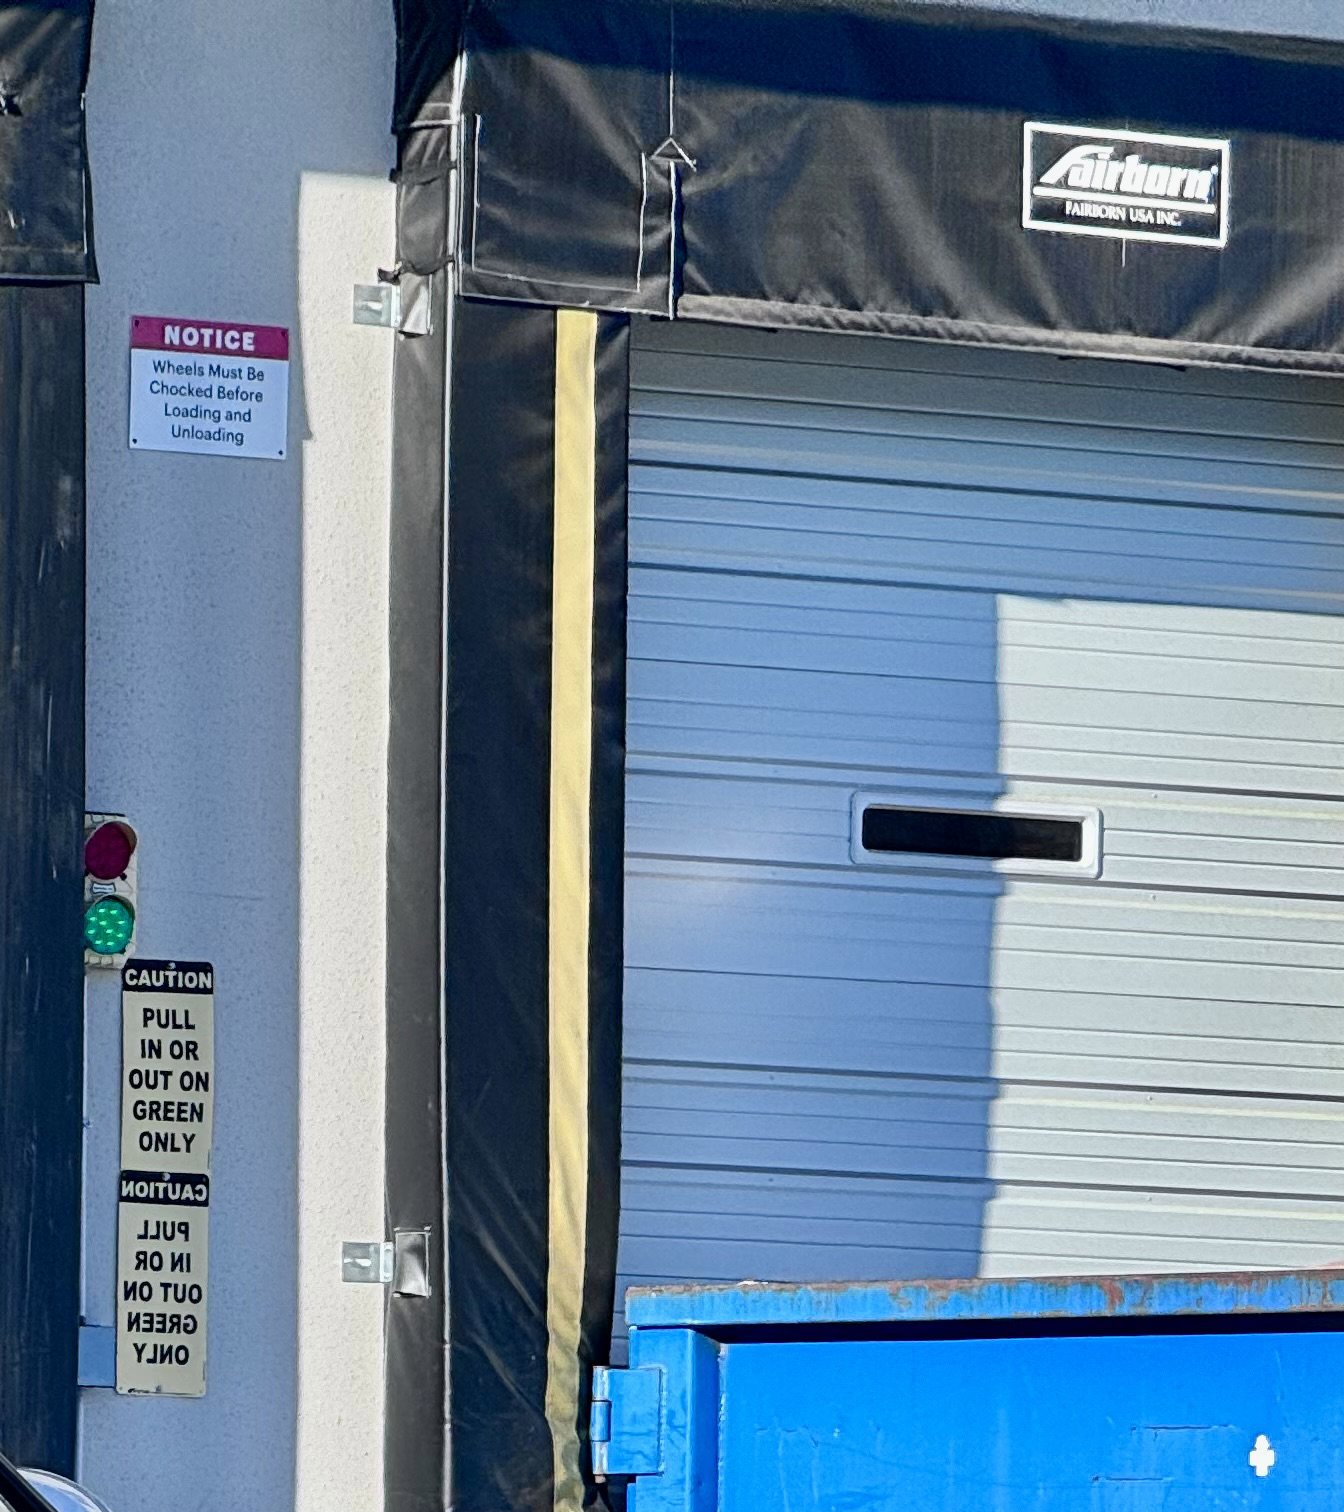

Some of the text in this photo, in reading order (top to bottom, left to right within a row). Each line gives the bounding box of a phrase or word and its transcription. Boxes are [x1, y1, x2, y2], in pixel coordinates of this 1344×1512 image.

[1065, 201, 1126, 221] FAIRBORN
[1129, 207, 1155, 224] USA
[164, 324, 256, 351] NOTICE
[152, 360, 265, 382] Wheels Must Be
[149, 380, 263, 403] Chocked Before
[164, 403, 252, 423] Loading and
[171, 424, 245, 447] Unloading
[125, 968, 212, 989] CAUTION
[142, 1007, 196, 1030] PULL
[140, 1038, 199, 1061] IN OR
[128, 1068, 209, 1092] OUT ON
[132, 1099, 204, 1123] GREEN
[138, 1131, 196, 1153] ONLY
